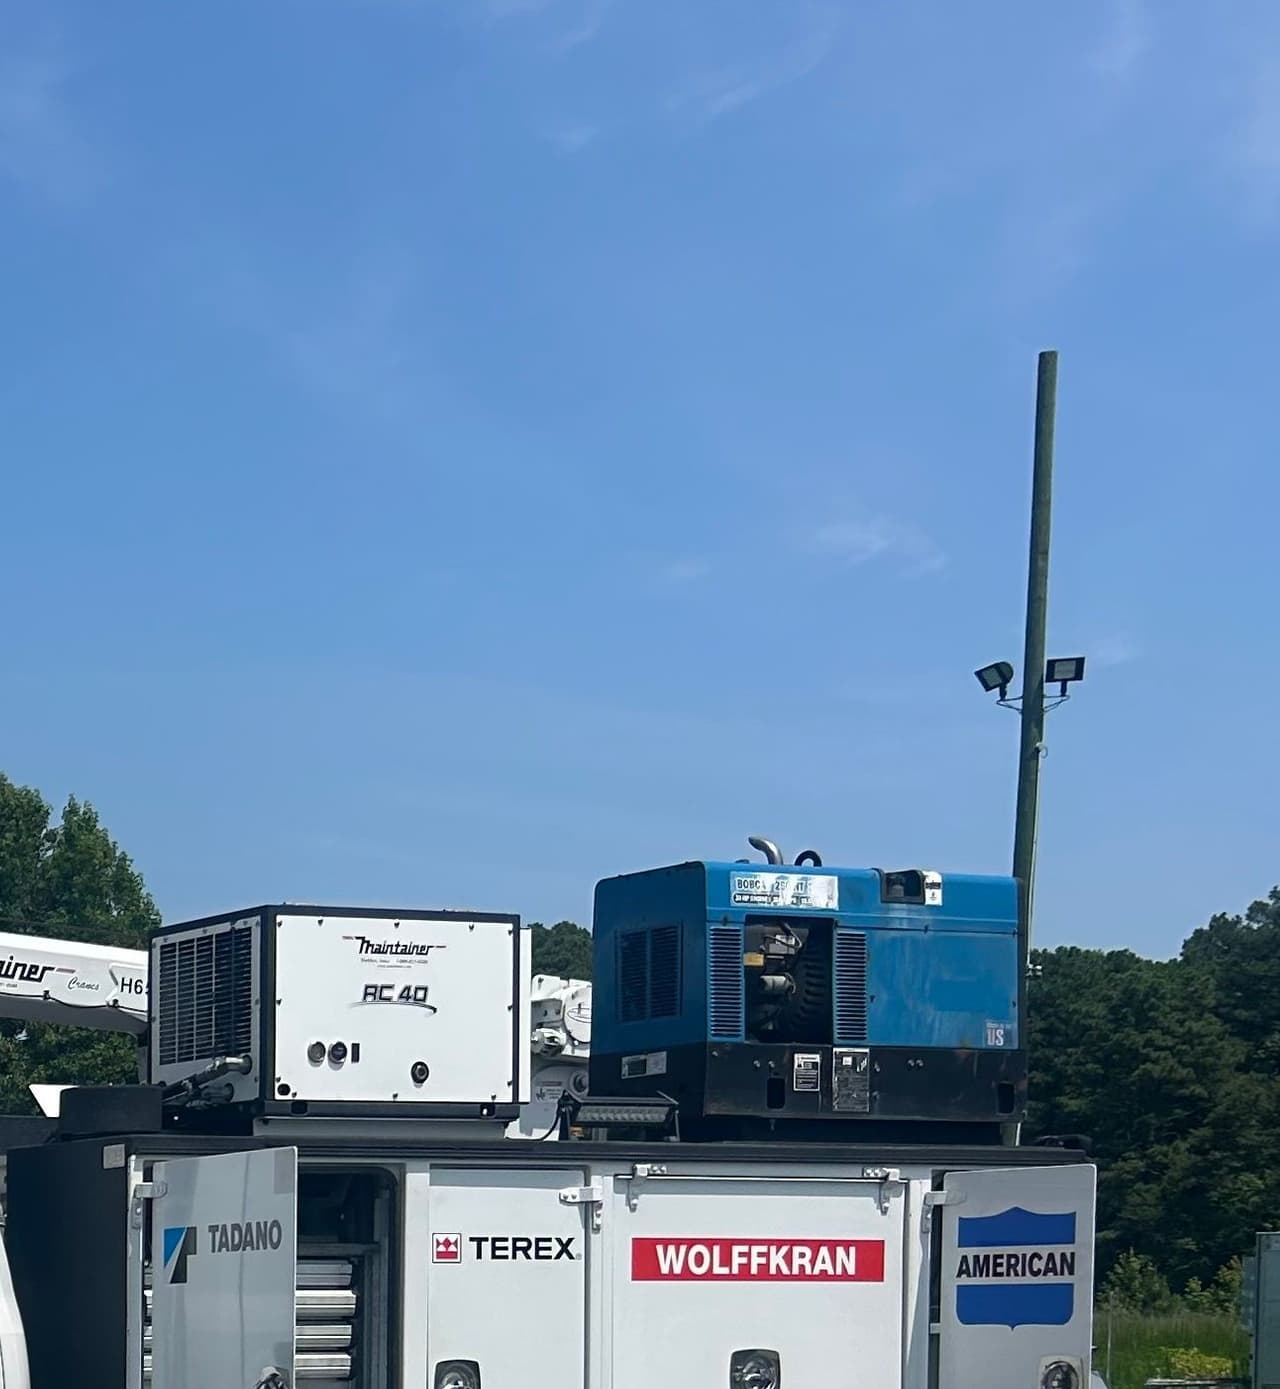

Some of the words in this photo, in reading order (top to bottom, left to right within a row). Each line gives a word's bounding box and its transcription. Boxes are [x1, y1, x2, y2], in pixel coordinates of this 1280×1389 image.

[355, 936, 435, 956] Maintainer
[120, 977, 149, 995] H6
[397, 984, 429, 1002] 40
[207, 1219, 282, 1253] TADANO
[469, 1237, 576, 1260] TEREX
[656, 1244, 856, 1276] WOLFFKRAN
[956, 1252, 1076, 1278] AMERICAN
